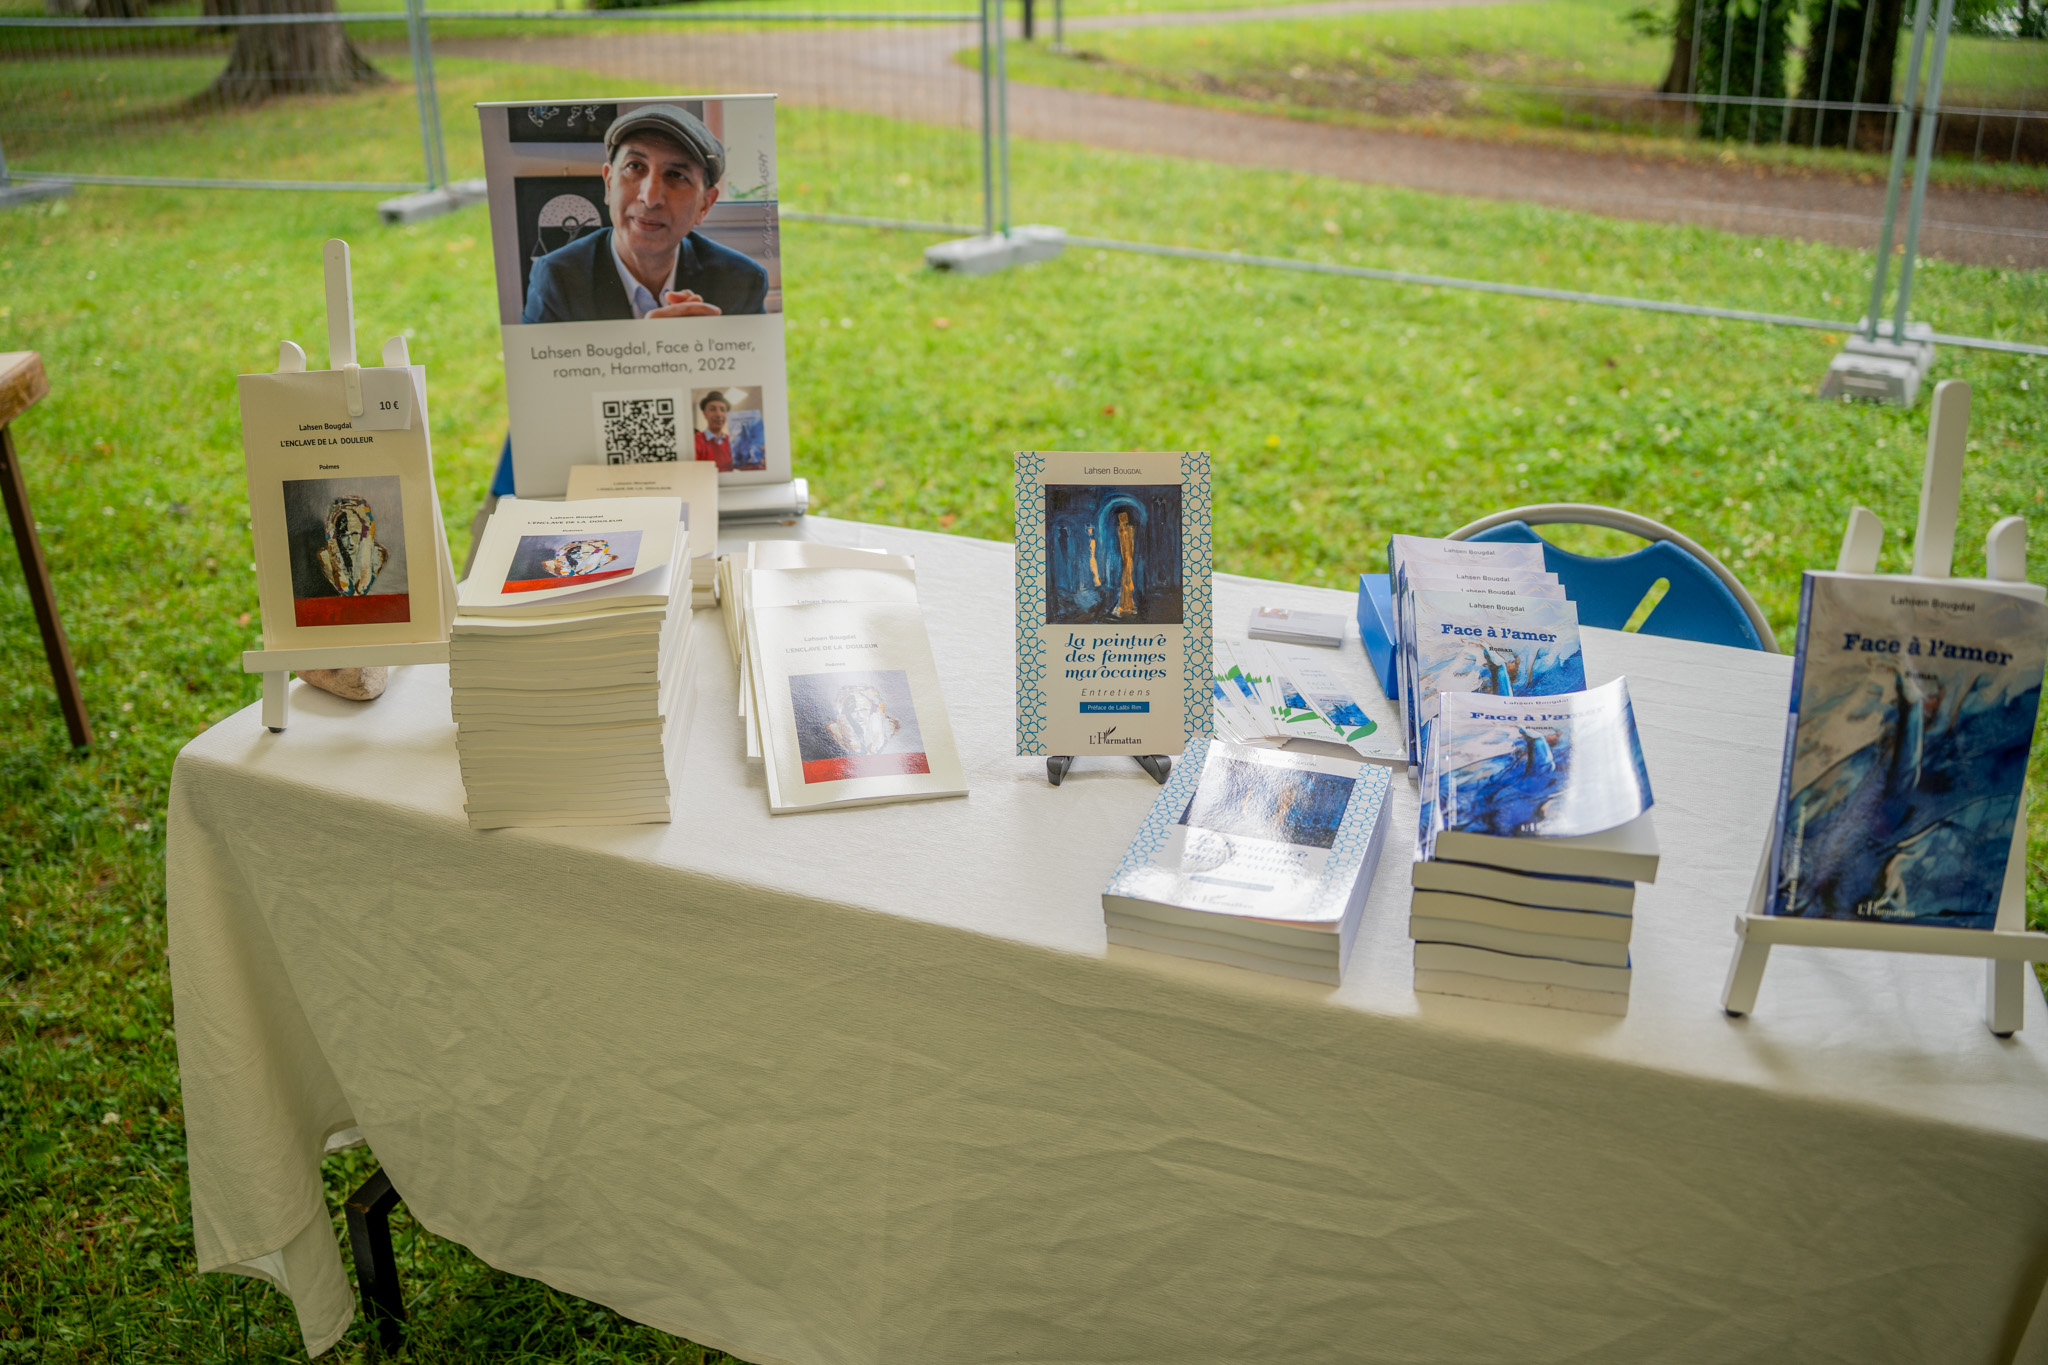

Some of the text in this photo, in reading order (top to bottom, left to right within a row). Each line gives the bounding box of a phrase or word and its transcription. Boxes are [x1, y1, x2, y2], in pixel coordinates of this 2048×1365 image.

[531, 338, 755, 360] Lahsen Bougdal, Face à l'amer,
[553, 357, 736, 378] roman, Harmattan, 2022
[380, 401, 400, 410] 10 €
[324, 422, 352, 431] Bougdal
[280, 439, 316, 447] L'ENCLAVE
[340, 436, 374, 444] DOULEUR
[1084, 466, 1111, 475] Lahsen
[1456, 573, 1481, 581] Lahsen
[1469, 602, 1525, 612] Lahsen Bougdal
[1441, 623, 1557, 643] Face à l'amer
[1064, 633, 1167, 650] La peinture
[1842, 632, 2014, 666] Face à l'amer
[1065, 649, 1166, 665] des femmes
[1065, 664, 1167, 681] marocaines
[1081, 688, 1151, 696] Entretiens
[1470, 711, 1518, 721] Face
[1523, 713, 1536, 721] à
[1089, 731, 1142, 745] L'Harmattan
